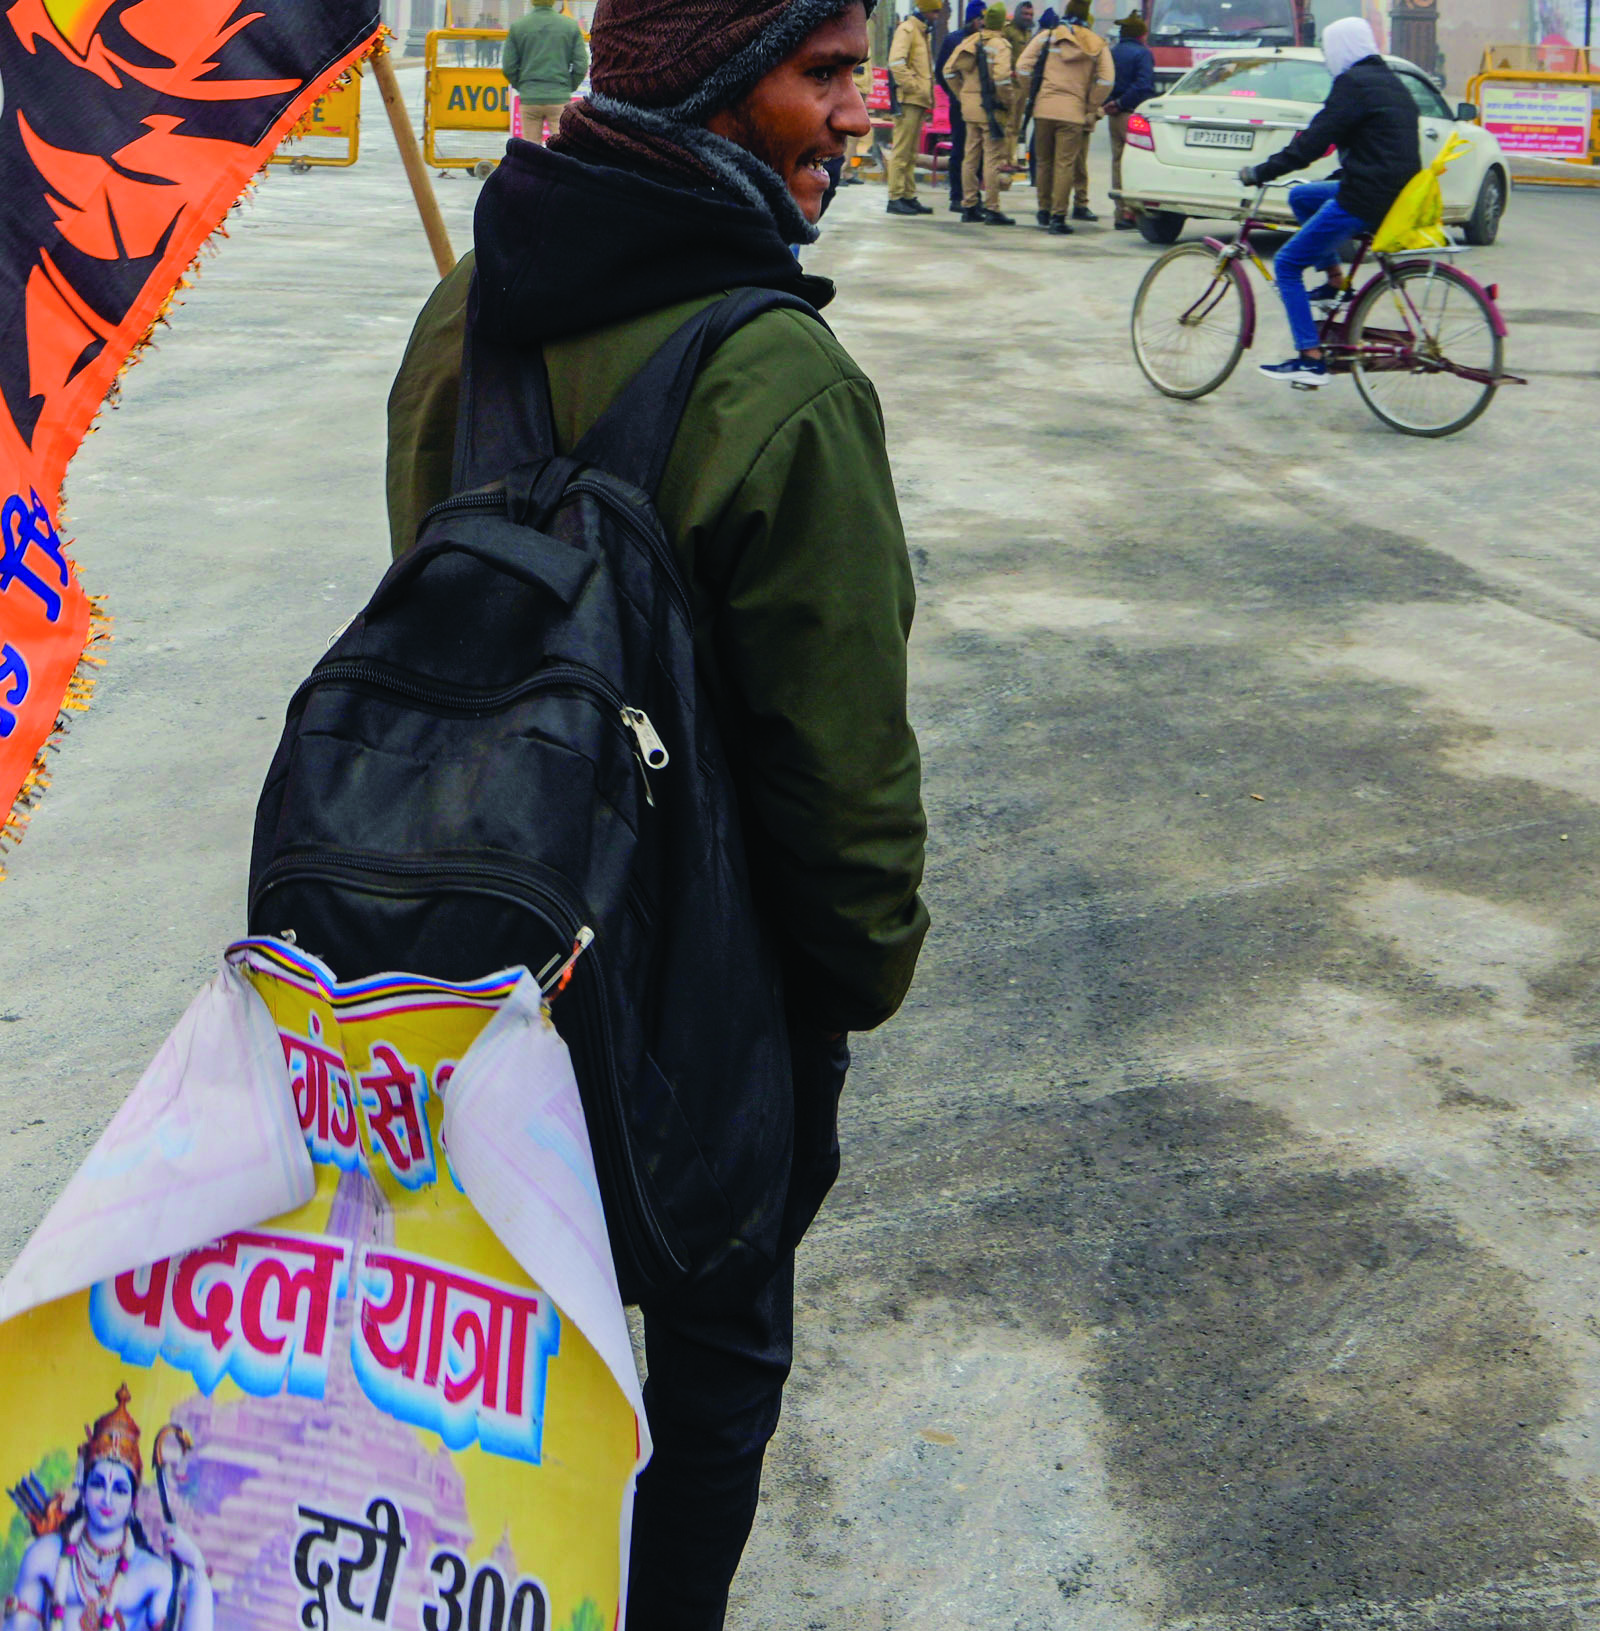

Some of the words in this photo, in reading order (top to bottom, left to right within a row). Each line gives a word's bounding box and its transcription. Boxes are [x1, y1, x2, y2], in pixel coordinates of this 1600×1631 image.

[448, 85, 510, 111] AYOD
[359, 1044, 425, 1172] से
[360, 1251, 539, 1417] यात्रा
[292, 1497, 407, 1631] दूरी
[422, 1551, 547, 1631] 300
